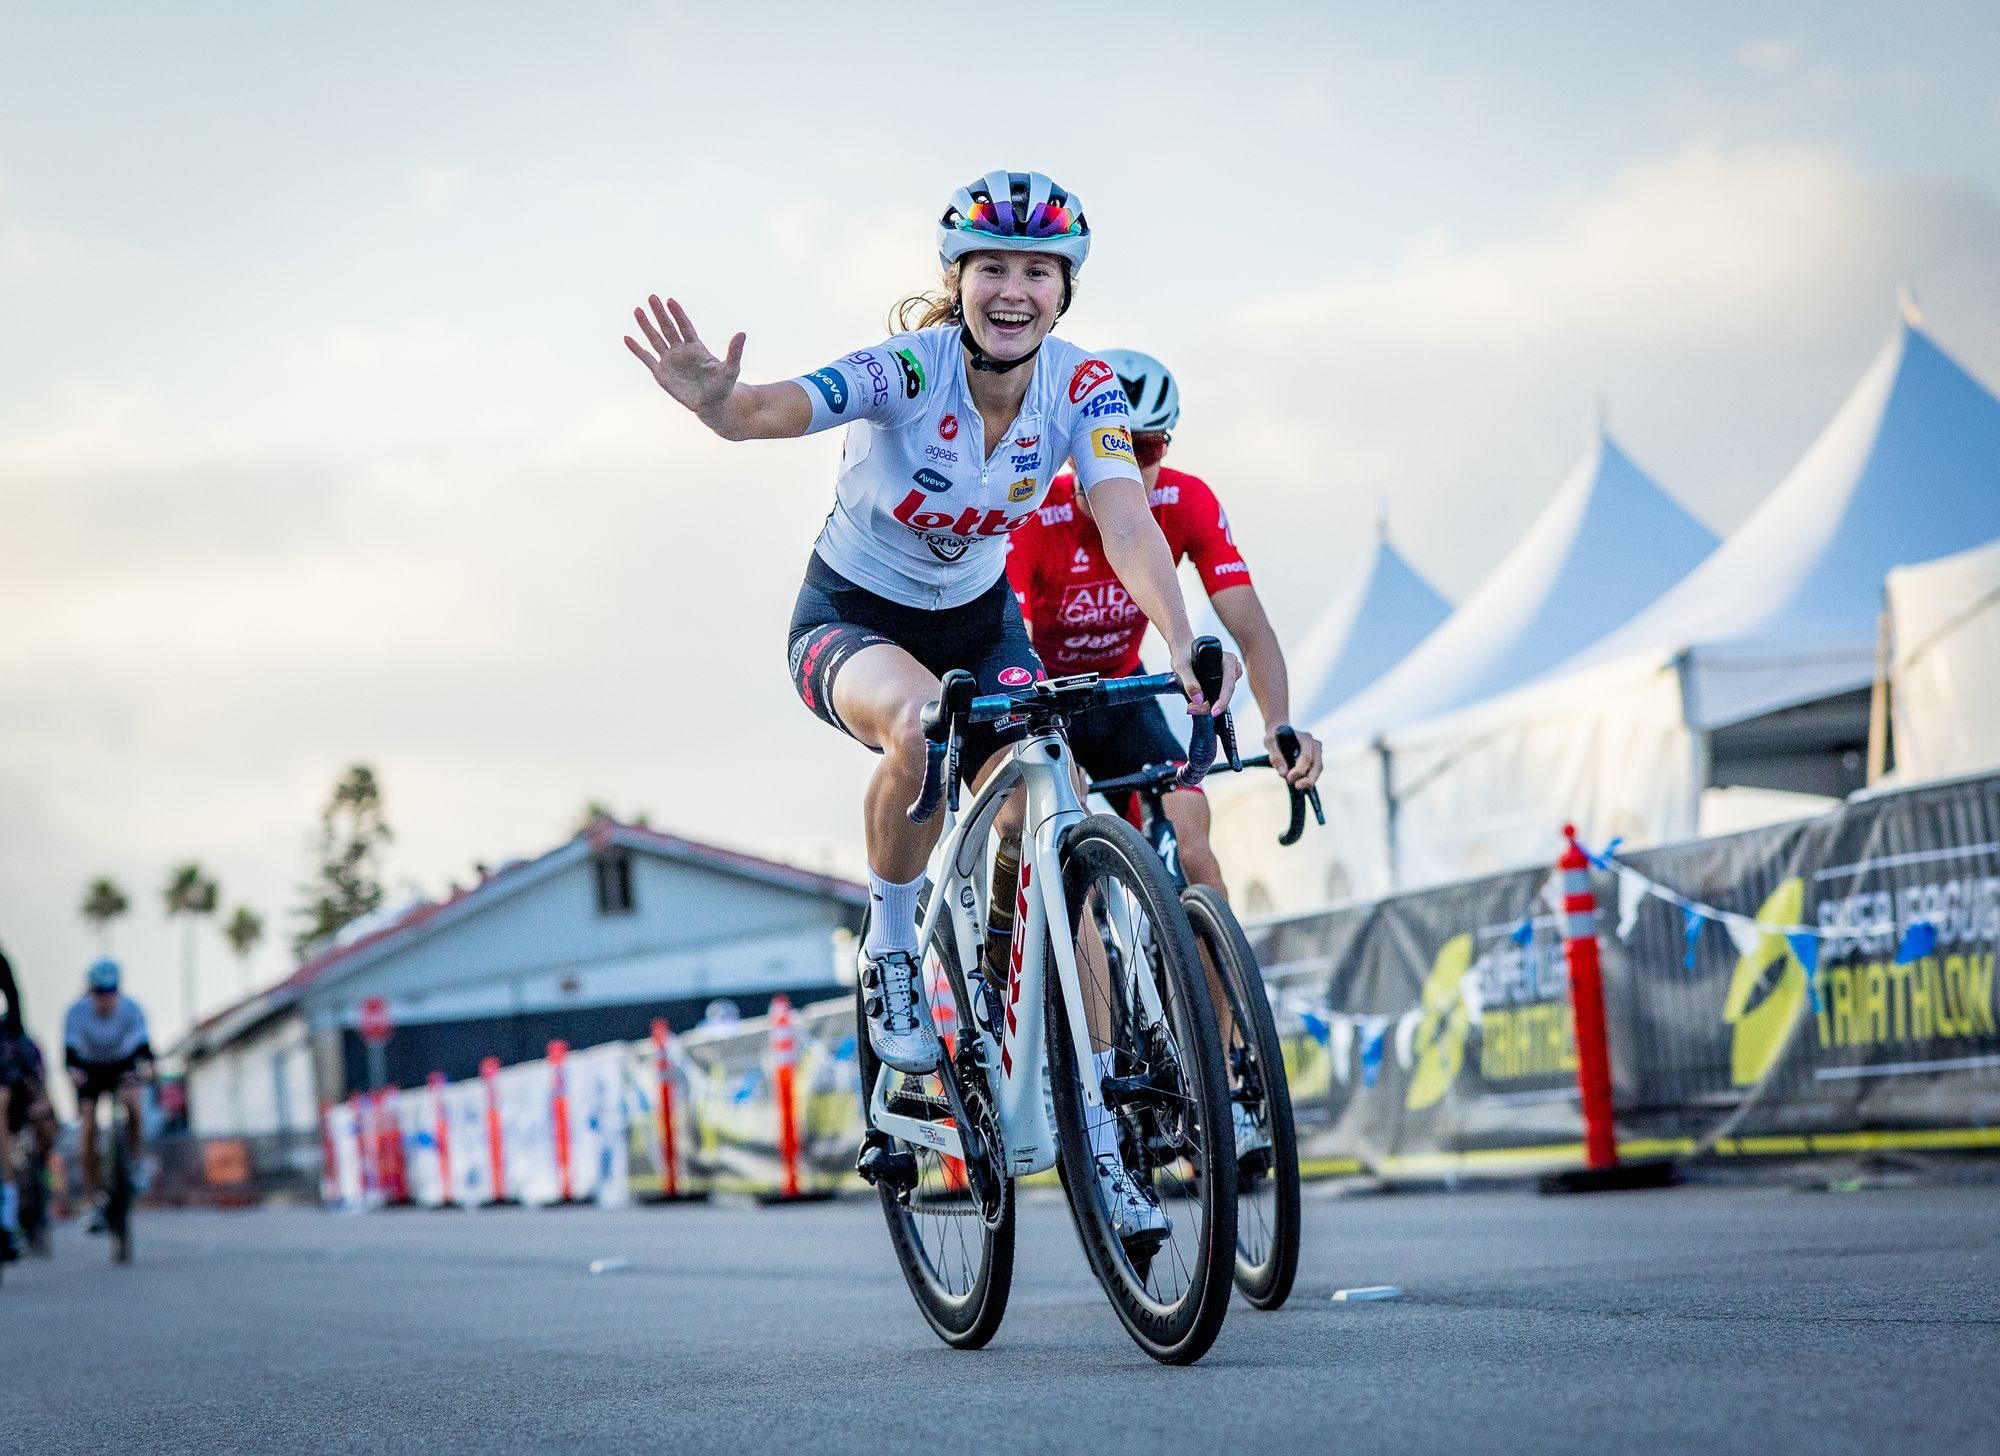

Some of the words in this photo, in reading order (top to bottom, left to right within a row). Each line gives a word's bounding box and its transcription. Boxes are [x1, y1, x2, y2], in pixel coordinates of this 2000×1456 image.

[925, 444, 959, 463] ageas
[1010, 452, 1038, 464] TOYO
[918, 473, 946, 488] Aveve
[892, 488, 1038, 538] lotto
[1066, 677, 1090, 685] GARMIN
[1812, 952, 1996, 1049] TRIATHLON
